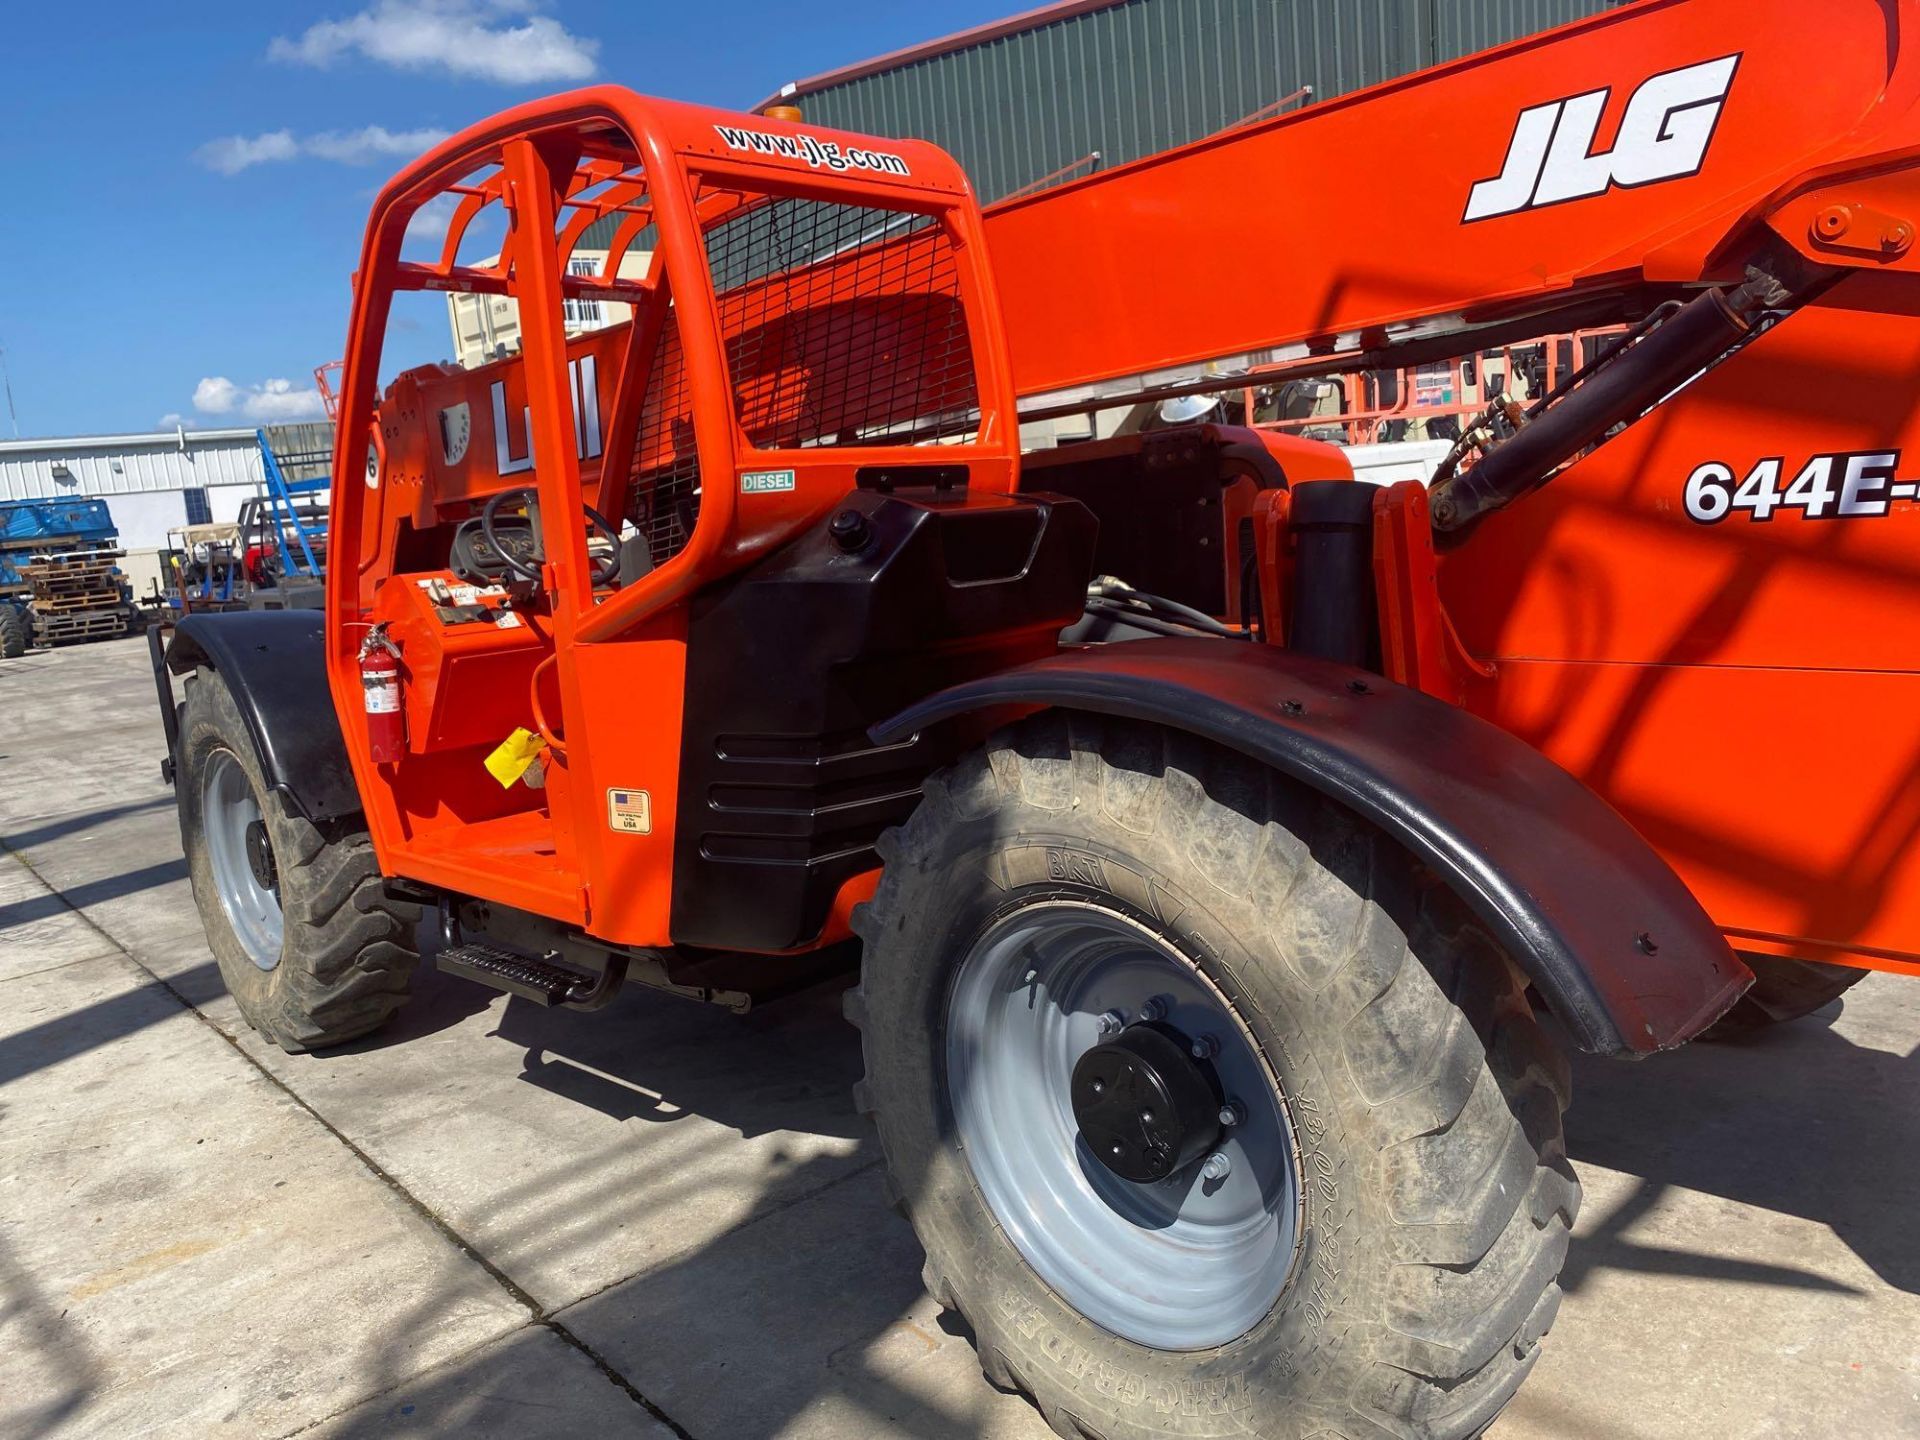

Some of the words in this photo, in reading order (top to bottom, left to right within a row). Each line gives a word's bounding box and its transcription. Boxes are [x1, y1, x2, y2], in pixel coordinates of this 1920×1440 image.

[715, 126, 910, 175] www.jlg.com
[1460, 52, 1743, 224] JLG
[743, 473, 792, 490] DIESEL
[1684, 450, 1920, 524] 644E-
[623, 820, 637, 828] USA
[1048, 850, 1102, 886] BKT
[998, 1288, 1146, 1407] GRADER
[1155, 1371, 1252, 1418] TRAC
